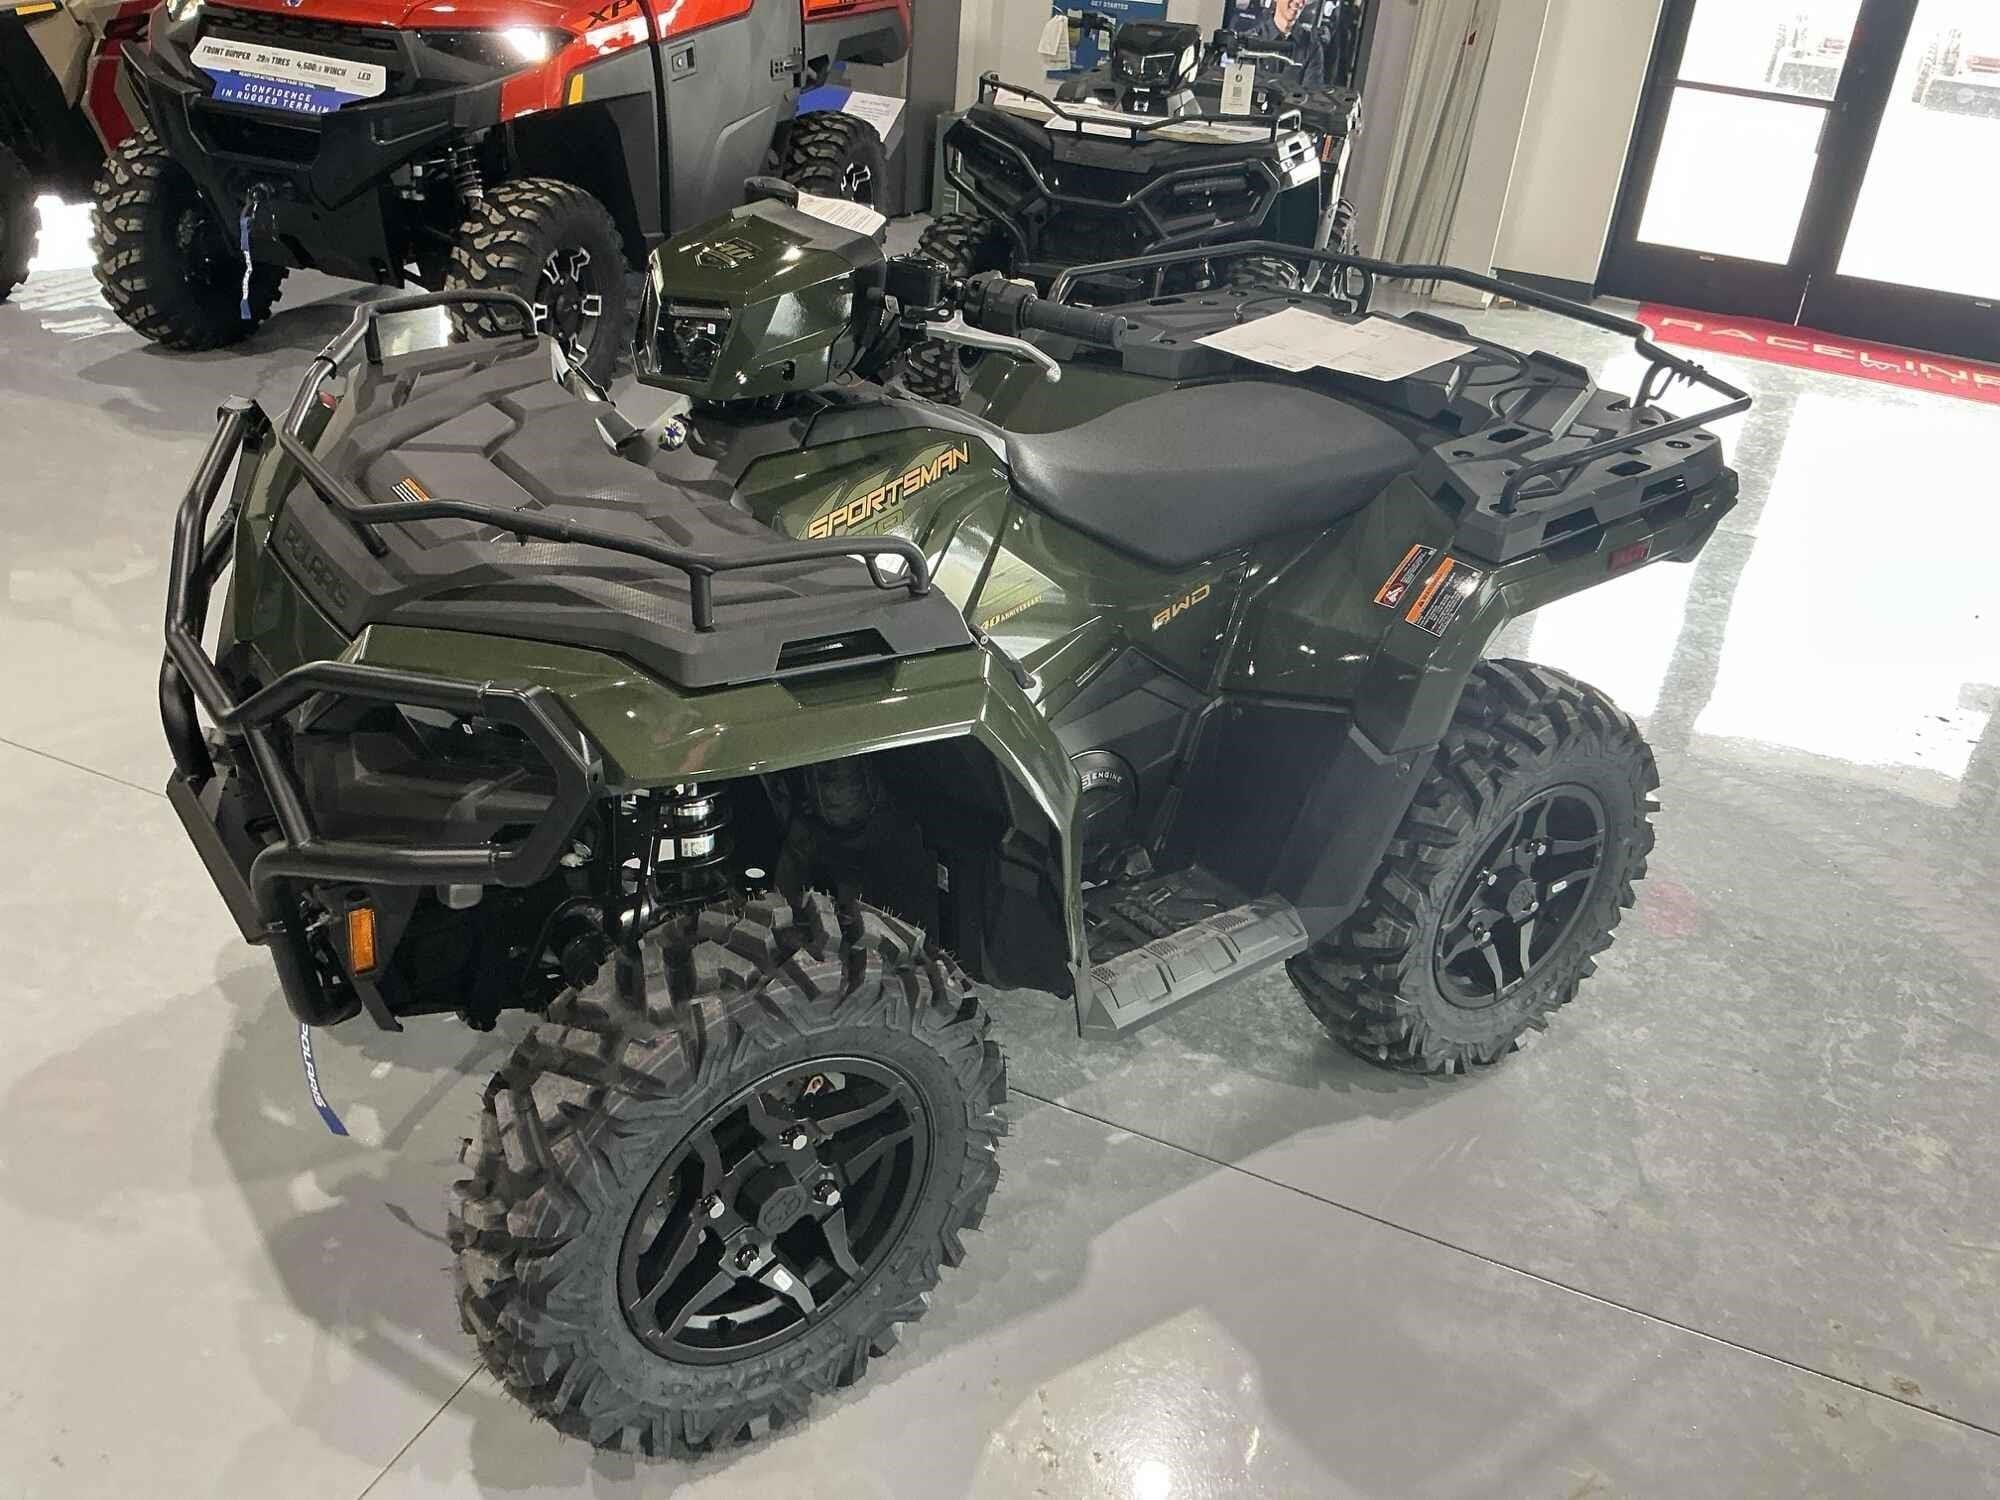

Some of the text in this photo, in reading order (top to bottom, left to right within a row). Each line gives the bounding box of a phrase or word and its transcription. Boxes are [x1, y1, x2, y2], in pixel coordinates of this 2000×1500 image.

[585, 0, 633, 29] XP
[202, 45, 224, 57] FRONT
[225, 47, 251, 60] BUMPER
[271, 56, 291, 67] TIRES
[323, 65, 348, 77] WINCH
[356, 71, 372, 81] LED
[221, 88, 330, 114] IN RUGGED TERRAIN
[244, 83, 312, 103] CONFIDENCE
[808, 440, 970, 540] SPORTSMAN
[1092, 771, 1122, 783] ENGINE
